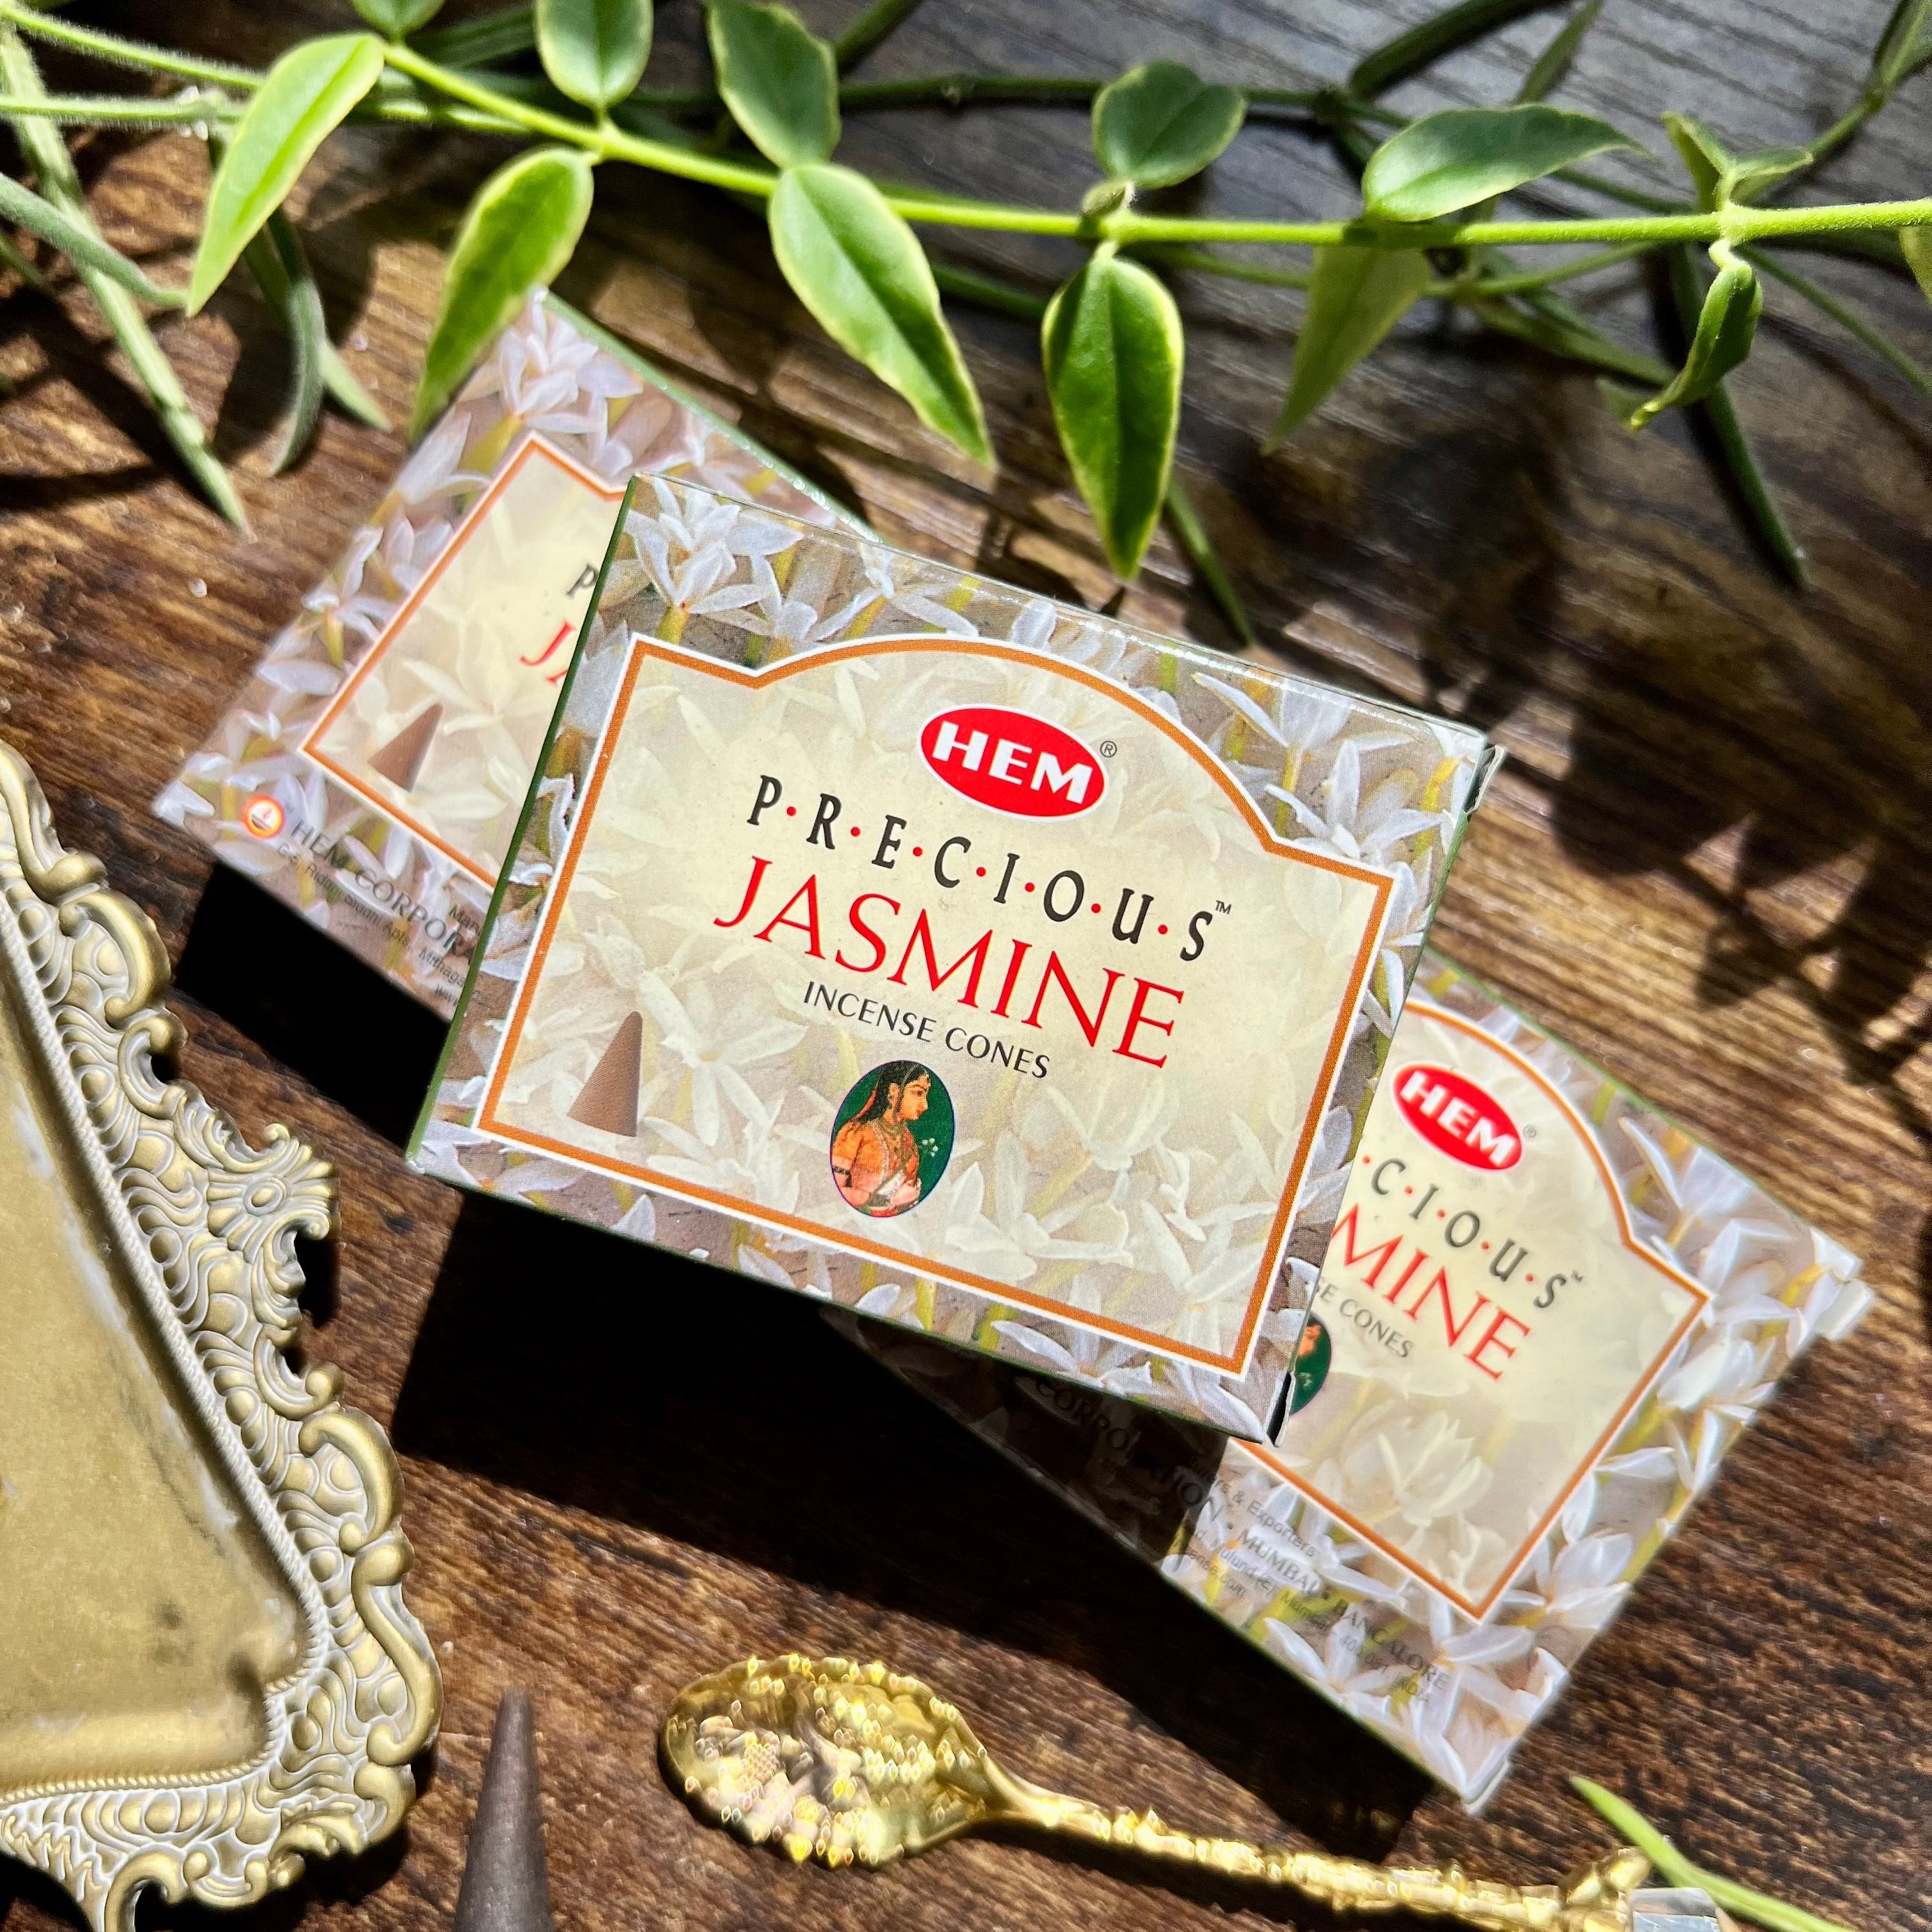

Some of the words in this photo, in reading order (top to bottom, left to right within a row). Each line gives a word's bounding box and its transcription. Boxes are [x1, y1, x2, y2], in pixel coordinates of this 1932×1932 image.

[933, 718, 1094, 805] HEM
[714, 855, 1185, 1069] JASMINE
[803, 981, 936, 1043] INCENSE
[946, 1028, 1052, 1079] CONES
[1399, 1070, 1516, 1168] HEM
[1339, 1298, 1413, 1358] CONES
[1237, 1528, 1319, 1593] MUMBAI
